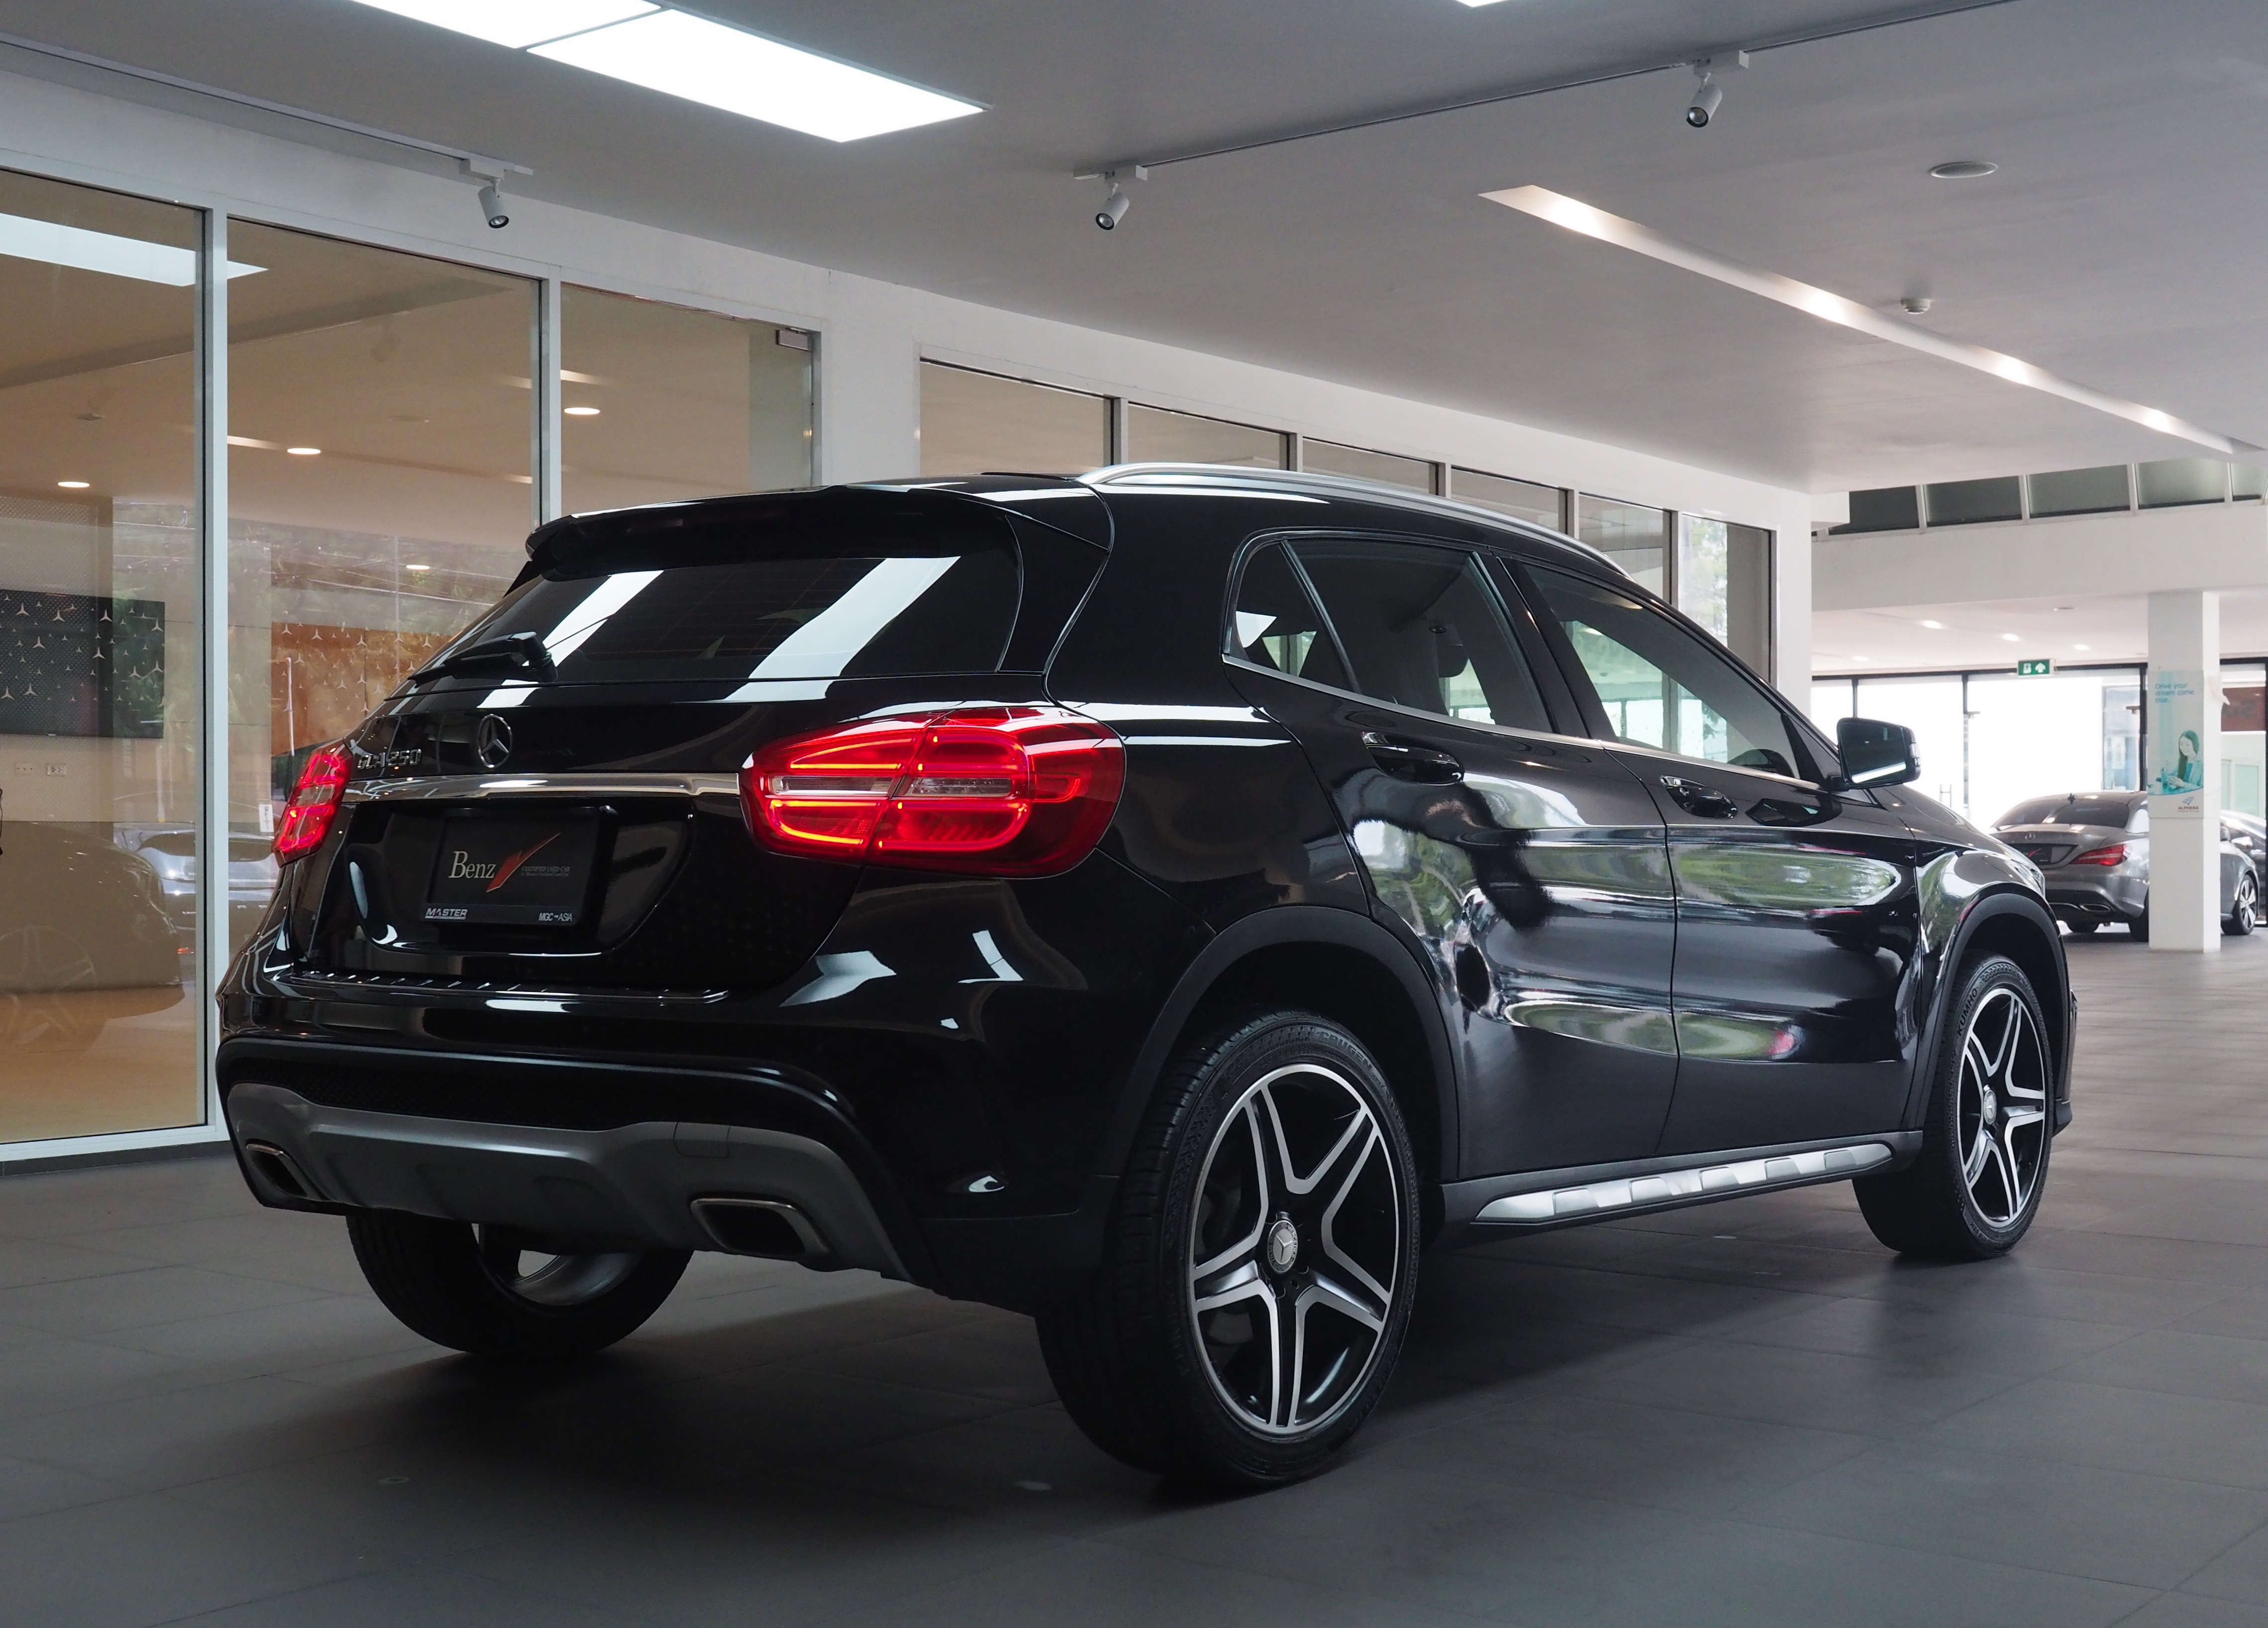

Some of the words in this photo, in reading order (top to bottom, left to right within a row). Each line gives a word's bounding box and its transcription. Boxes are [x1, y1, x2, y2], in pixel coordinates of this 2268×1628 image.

[387, 749, 422, 767] 250
[448, 851, 496, 879] Benz
[426, 908, 468, 917] MASTER
[1957, 988, 1978, 1036] KUMHO
[1320, 1031, 1373, 1071] CRUGEN
